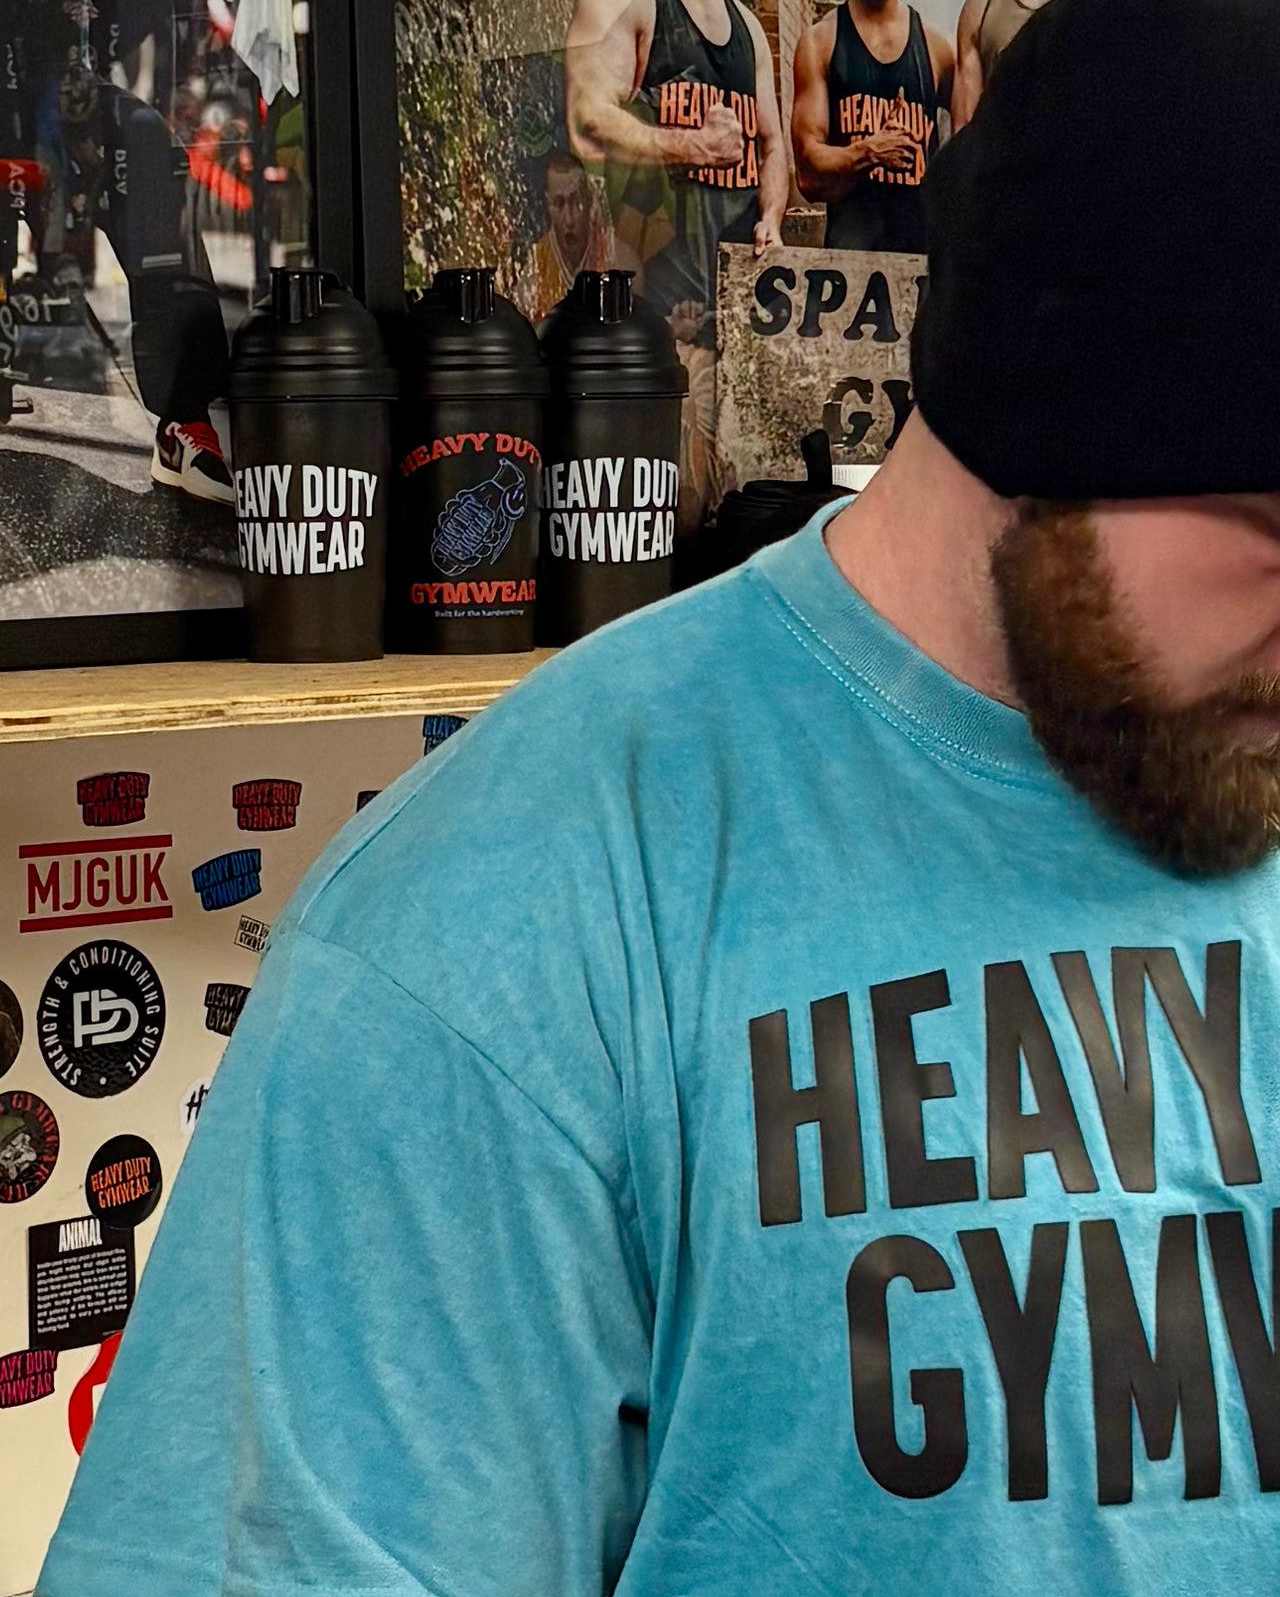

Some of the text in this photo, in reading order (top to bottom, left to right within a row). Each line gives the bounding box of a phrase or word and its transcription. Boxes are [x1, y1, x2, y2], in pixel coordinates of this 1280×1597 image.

[750, 265, 928, 342] SPA
[400, 433, 491, 477] HEAVY
[302, 464, 378, 518] DUTY
[543, 457, 625, 510] HEAVY
[238, 522, 365, 575] GYMWEAR
[550, 510, 674, 563] GYMWEAR
[410, 579, 536, 604] GYMWEAR
[28, 852, 168, 914] MJGUK
[194, 852, 259, 891] HEAVY DUTY
[203, 873, 259, 908] GYMWEAR
[42, 946, 160, 1085] STRENGTH & CONDITIONING SUITE
[748, 939, 1263, 1228] HEAVY
[91, 1156, 151, 1192] HEAVY DUTY
[99, 1180, 150, 1210] GYMWEAR
[59, 1218, 103, 1253] ANIMAL
[25, 1350, 57, 1375] DUTY
